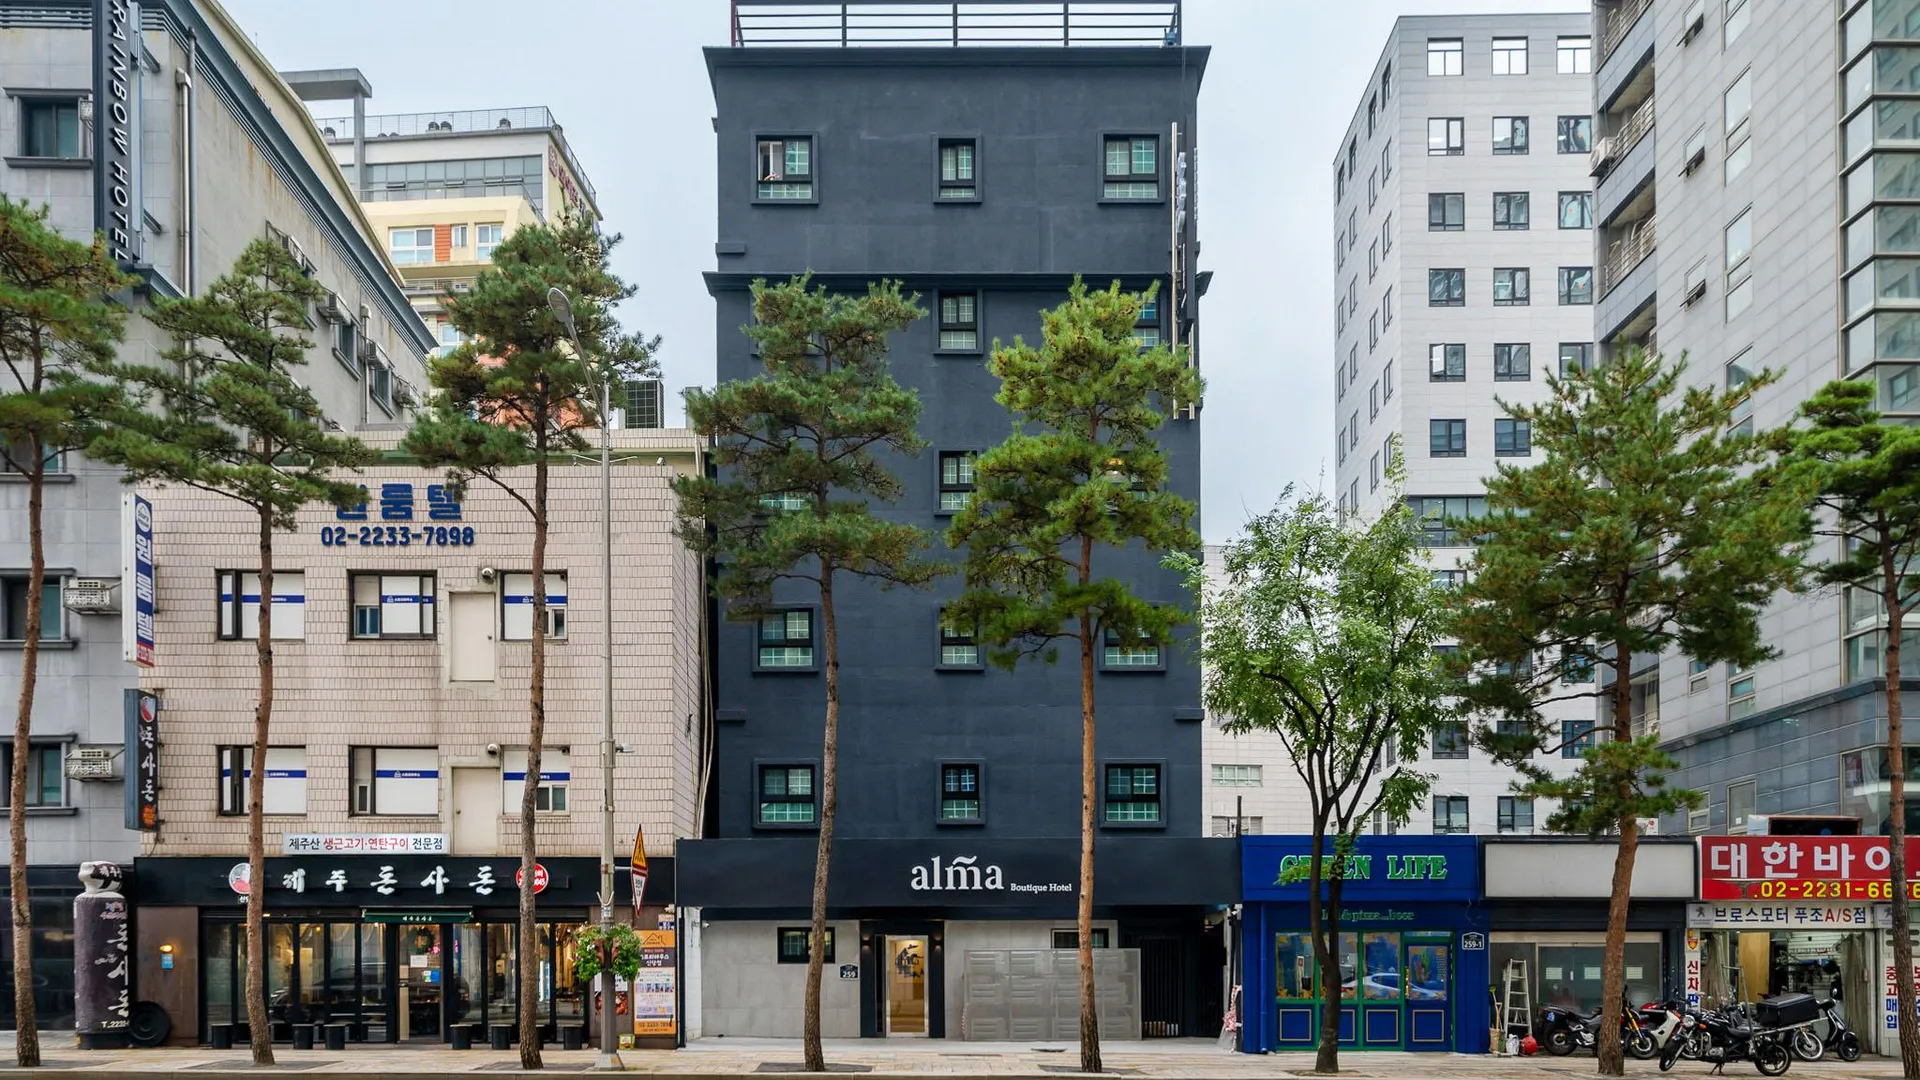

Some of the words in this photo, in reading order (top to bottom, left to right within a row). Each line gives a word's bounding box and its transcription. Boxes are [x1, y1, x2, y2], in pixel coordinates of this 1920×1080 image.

[112, 0, 128, 156] RAINBOW
[113, 161, 129, 261] HOTEL
[321, 526, 475, 546] 02-2233-7898
[289, 837, 320, 850] 제주산
[412, 838, 443, 850] 전문점
[1387, 855, 1448, 880] LIFE
[1010, 882, 1048, 894] Boutique
[1049, 883, 1072, 892] Hotel
[1714, 907, 1789, 924] 브로스모터
[1794, 906, 1867, 924] 푸조A/S점
[1464, 940, 1482, 948] 259-1
[842, 970, 857, 978] 259
